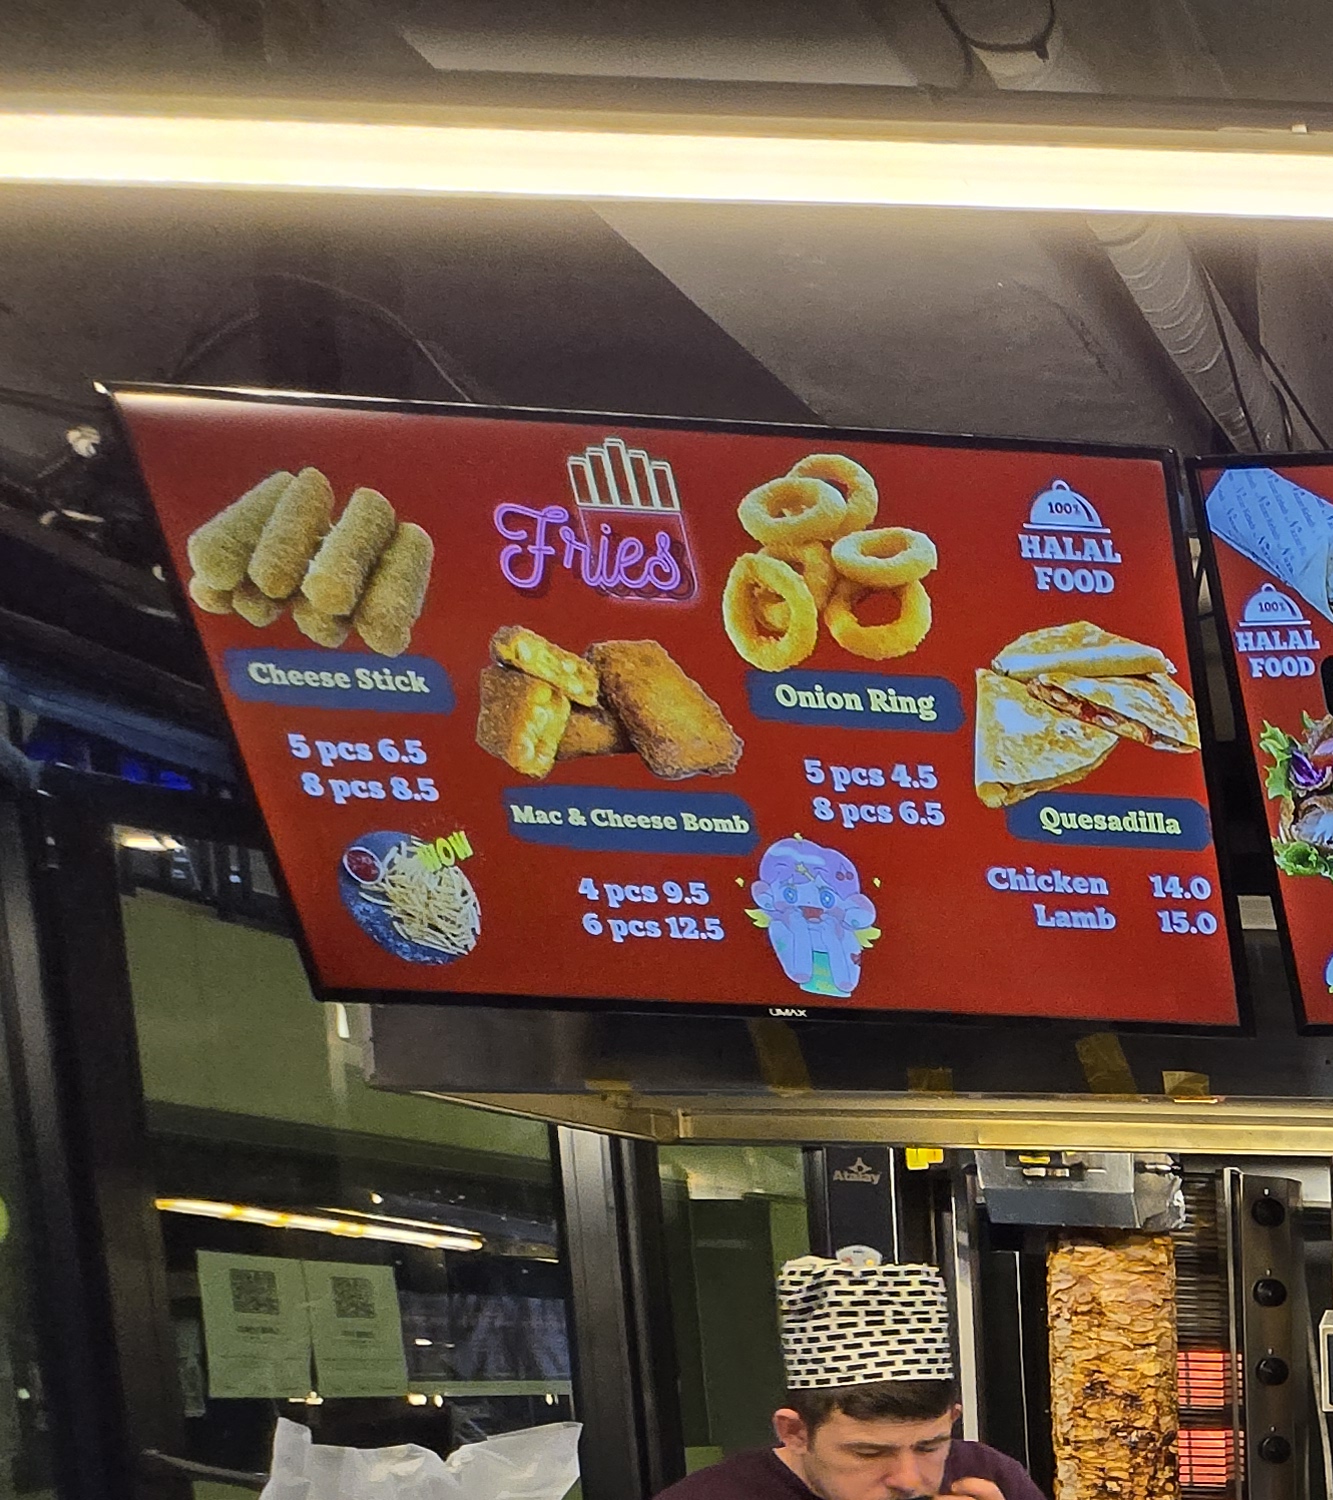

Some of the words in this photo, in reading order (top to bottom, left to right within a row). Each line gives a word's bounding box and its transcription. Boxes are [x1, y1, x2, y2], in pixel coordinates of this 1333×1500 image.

[495, 503, 682, 590] Fries
[1019, 535, 1121, 564] HALAL
[1035, 567, 1115, 594] FOOD
[1236, 630, 1319, 651] HALAL
[248, 661, 352, 690] Cheese
[356, 667, 430, 695] Stick
[1251, 657, 1314, 678] FOOD
[775, 685, 862, 712] Onion
[865, 690, 937, 721] Ring
[288, 734, 310, 759] 5
[316, 738, 373, 767] pcs
[377, 738, 427, 765] 6.5
[511, 804, 564, 826] Mac
[567, 808, 586, 827] &
[593, 809, 677, 830] Cheese
[680, 812, 749, 834] Bomb
[814, 798, 834, 820] 8
[841, 802, 894, 829] pcs
[898, 801, 944, 826] 6.5
[1039, 807, 1181, 836] Quesadilla
[418, 830, 474, 873] WOW
[987, 867, 1108, 895] Chicken
[1150, 876, 1211, 900] 14.0
[582, 913, 599, 934] 6
[606, 916, 661, 941] pcs
[665, 917, 724, 940] 12.5
[1034, 905, 1116, 930] Lamb
[1160, 911, 1217, 934] 15.0
